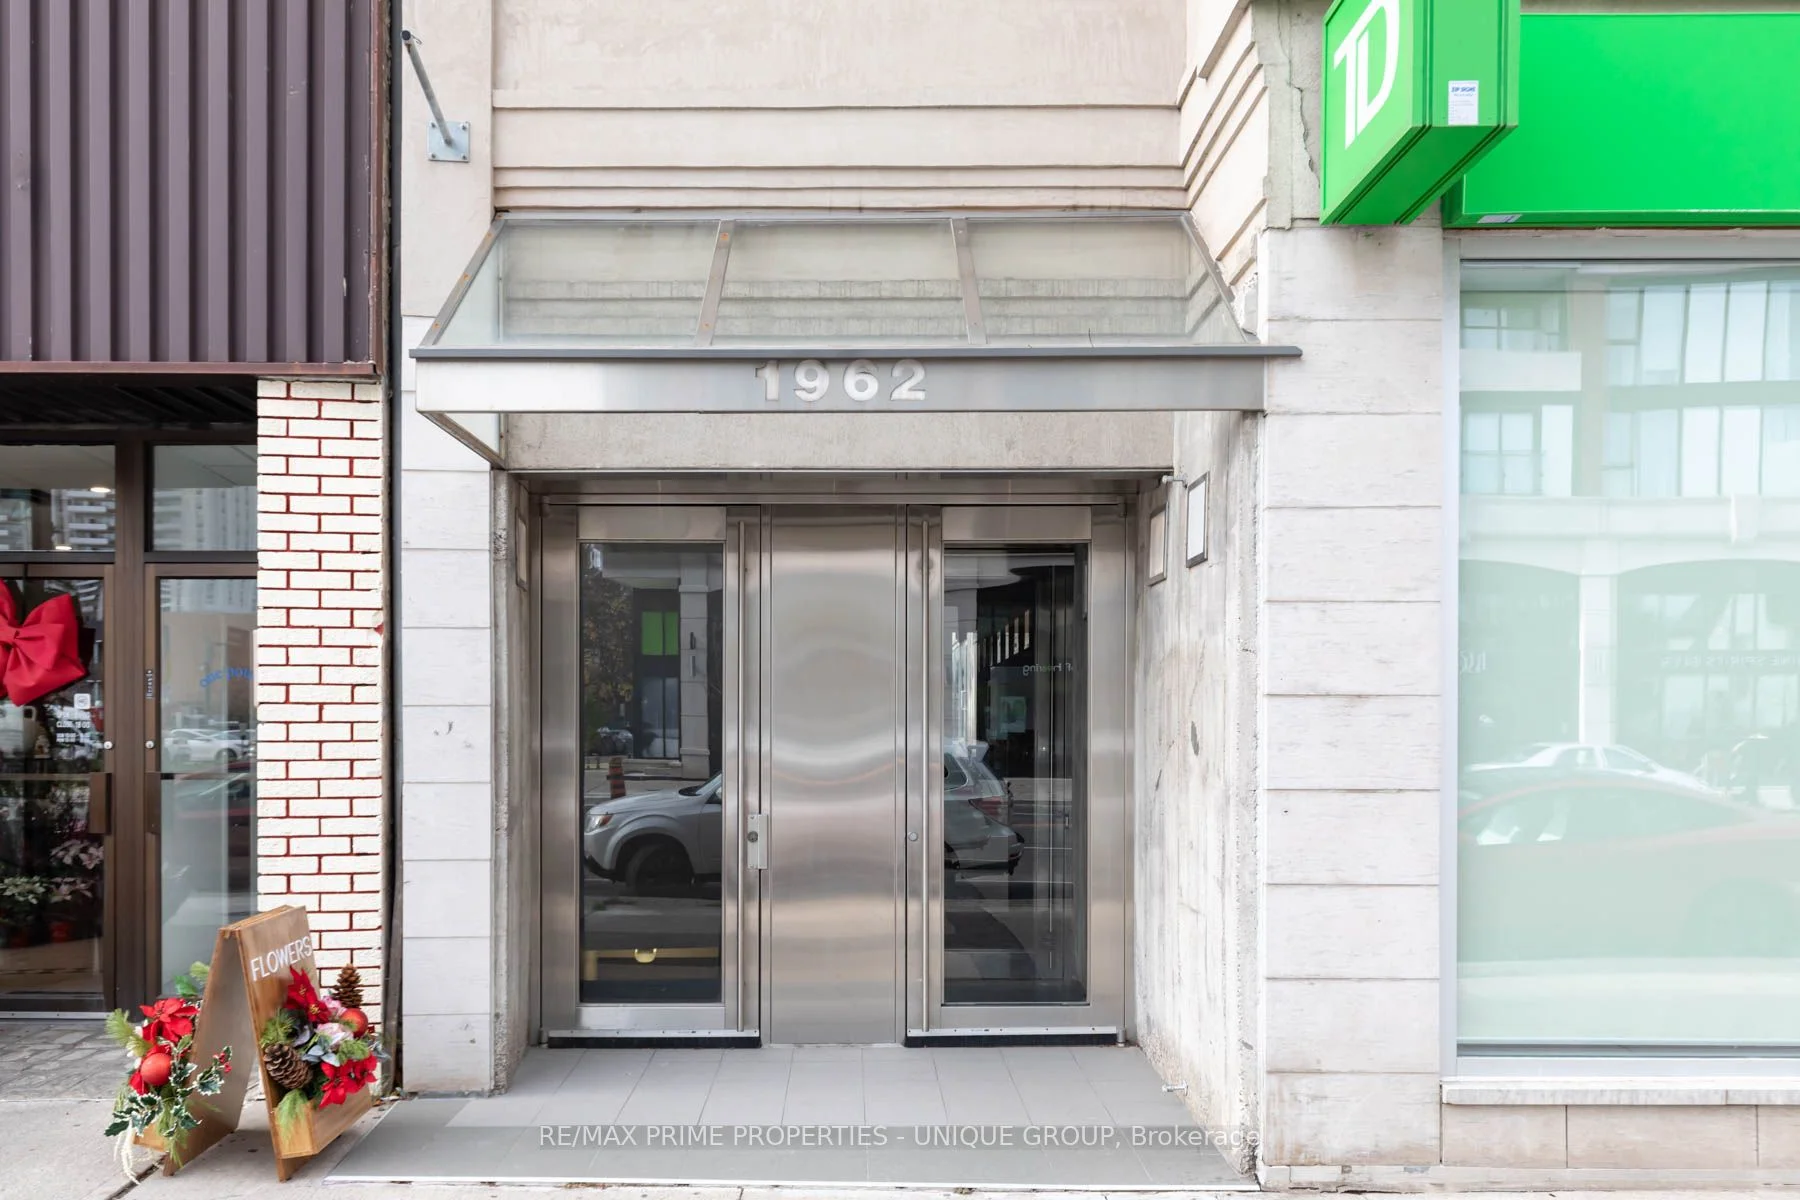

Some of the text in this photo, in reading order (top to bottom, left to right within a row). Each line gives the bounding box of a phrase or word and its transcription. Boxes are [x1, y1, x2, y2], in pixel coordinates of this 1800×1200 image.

[1333, 0, 1400, 151] TD
[754, 358, 927, 402] 1962
[250, 936, 313, 982] FLOWERS
